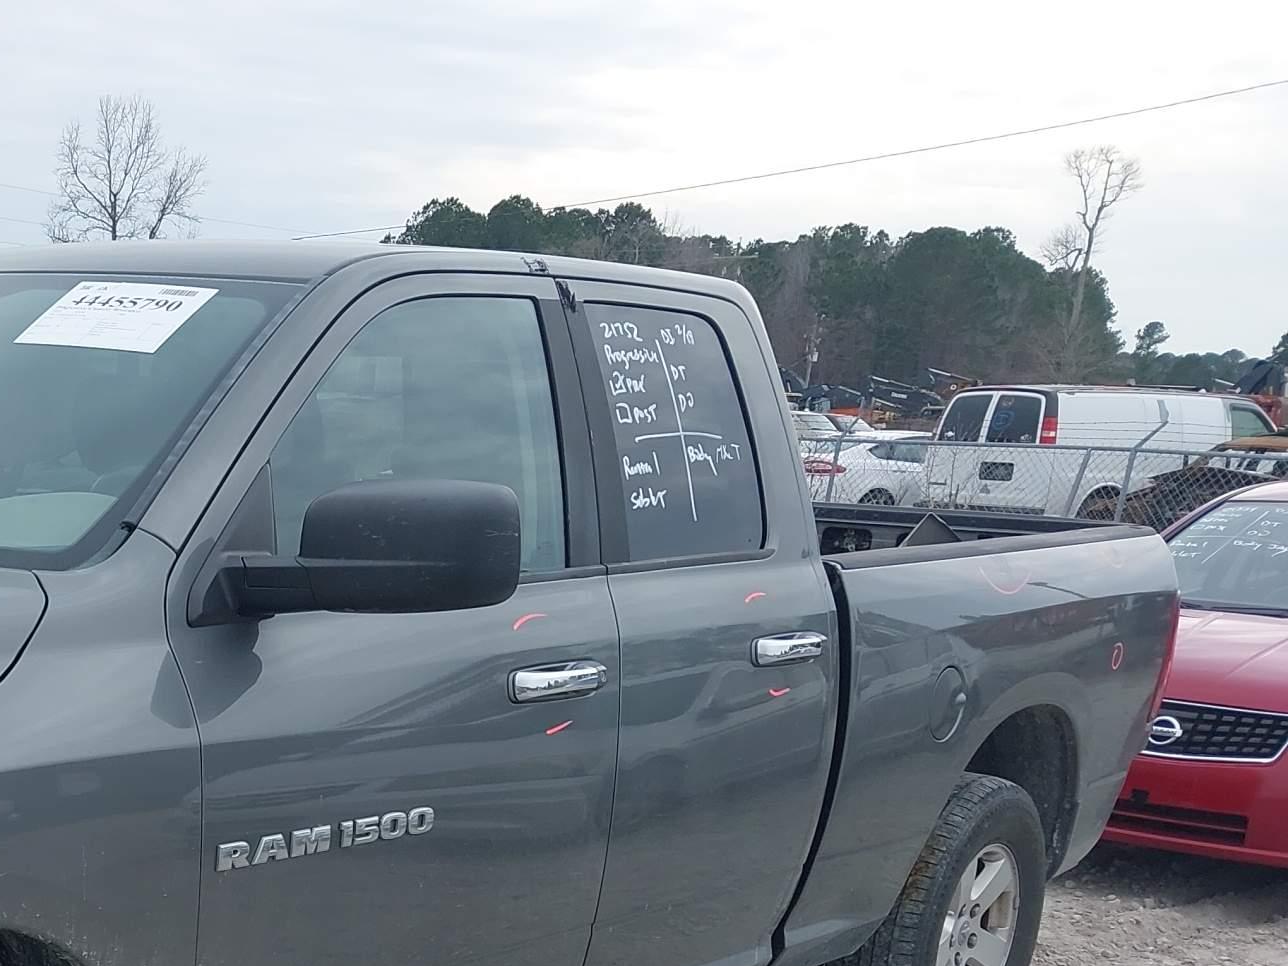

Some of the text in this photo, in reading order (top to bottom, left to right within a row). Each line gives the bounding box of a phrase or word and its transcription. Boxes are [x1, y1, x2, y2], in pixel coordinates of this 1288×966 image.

[72, 294, 184, 312] 44455790
[215, 806, 436, 873] RAM 1500
